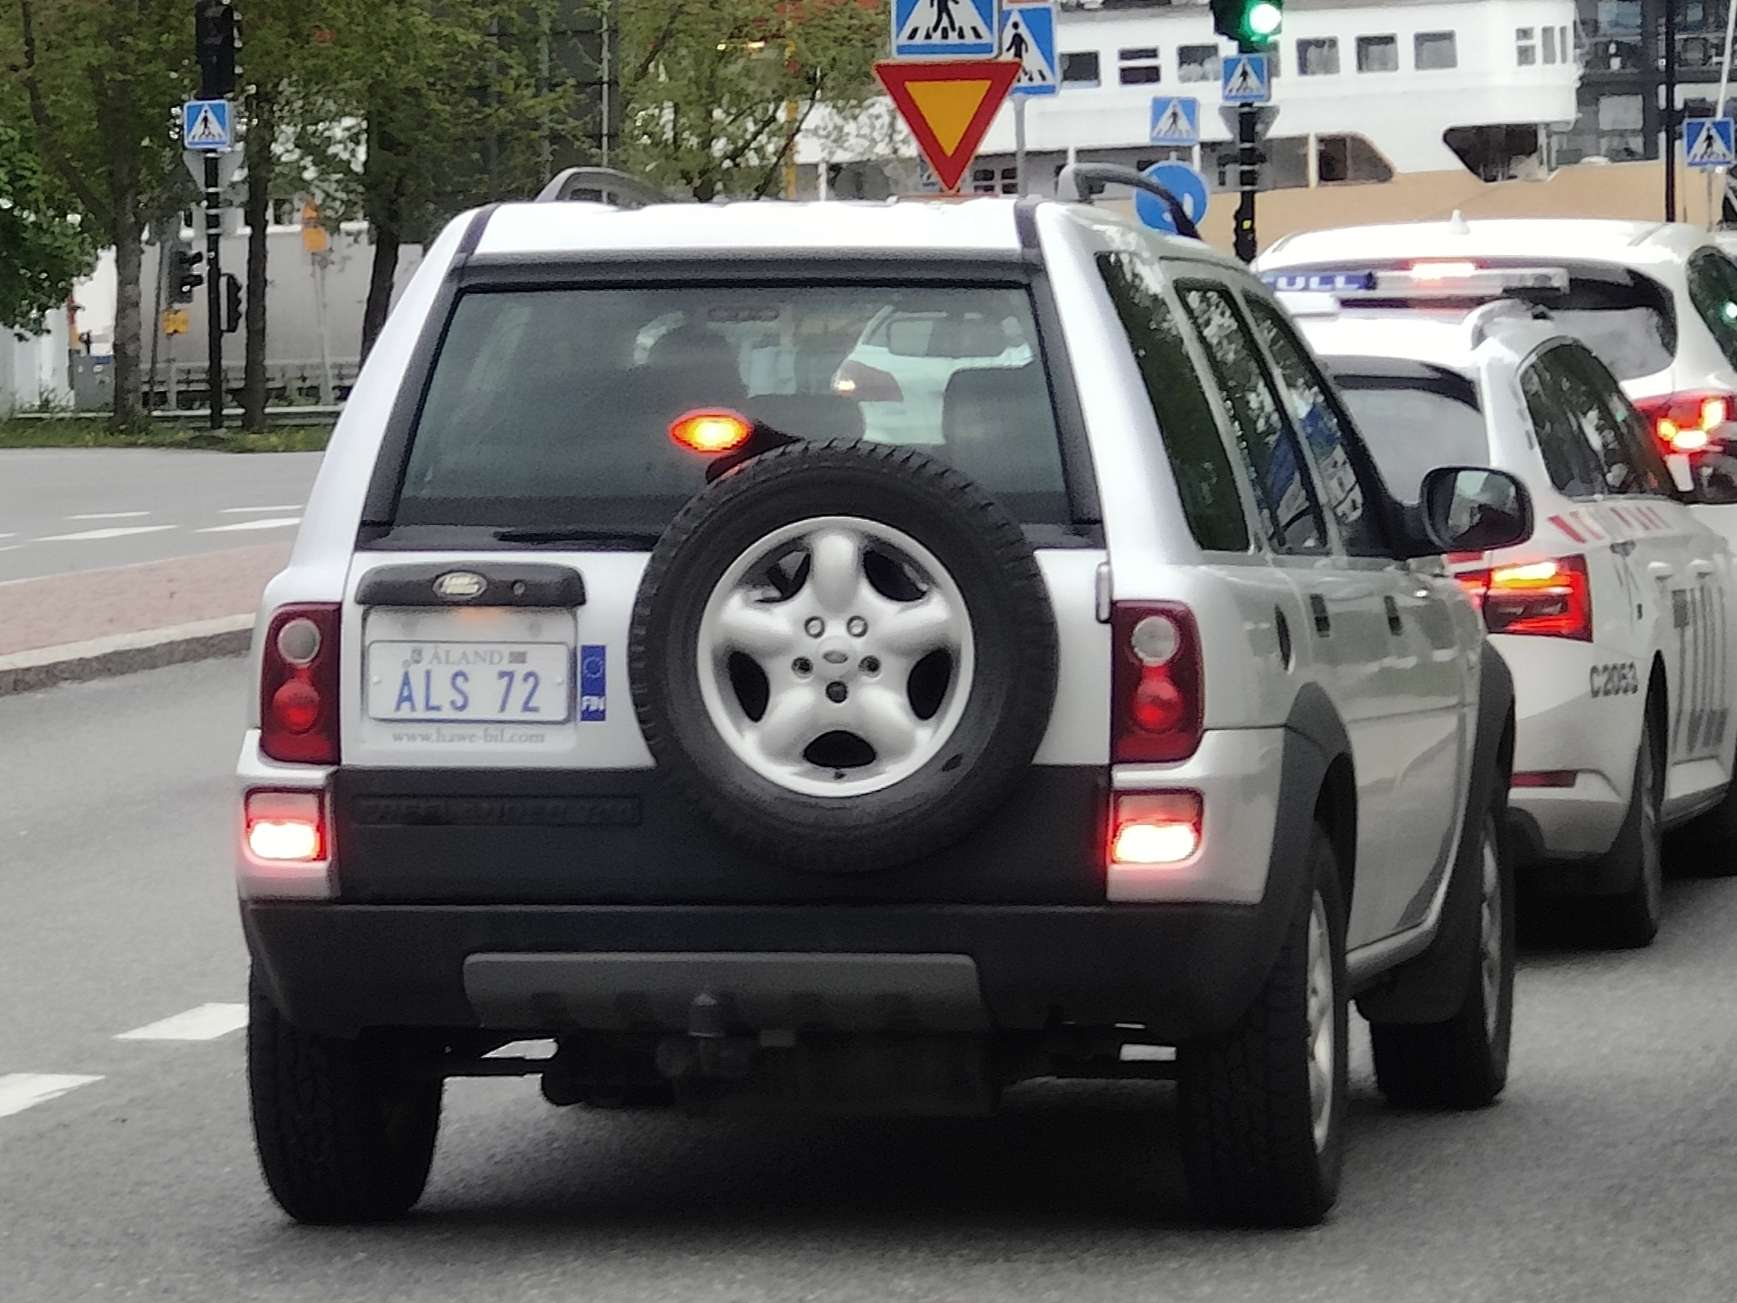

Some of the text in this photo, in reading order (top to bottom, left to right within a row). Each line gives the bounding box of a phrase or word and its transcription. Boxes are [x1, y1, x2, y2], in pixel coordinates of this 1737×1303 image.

[429, 648, 503, 665] ÅLAND
[394, 669, 541, 713] ALS 72
[1590, 661, 1638, 698] C2053
